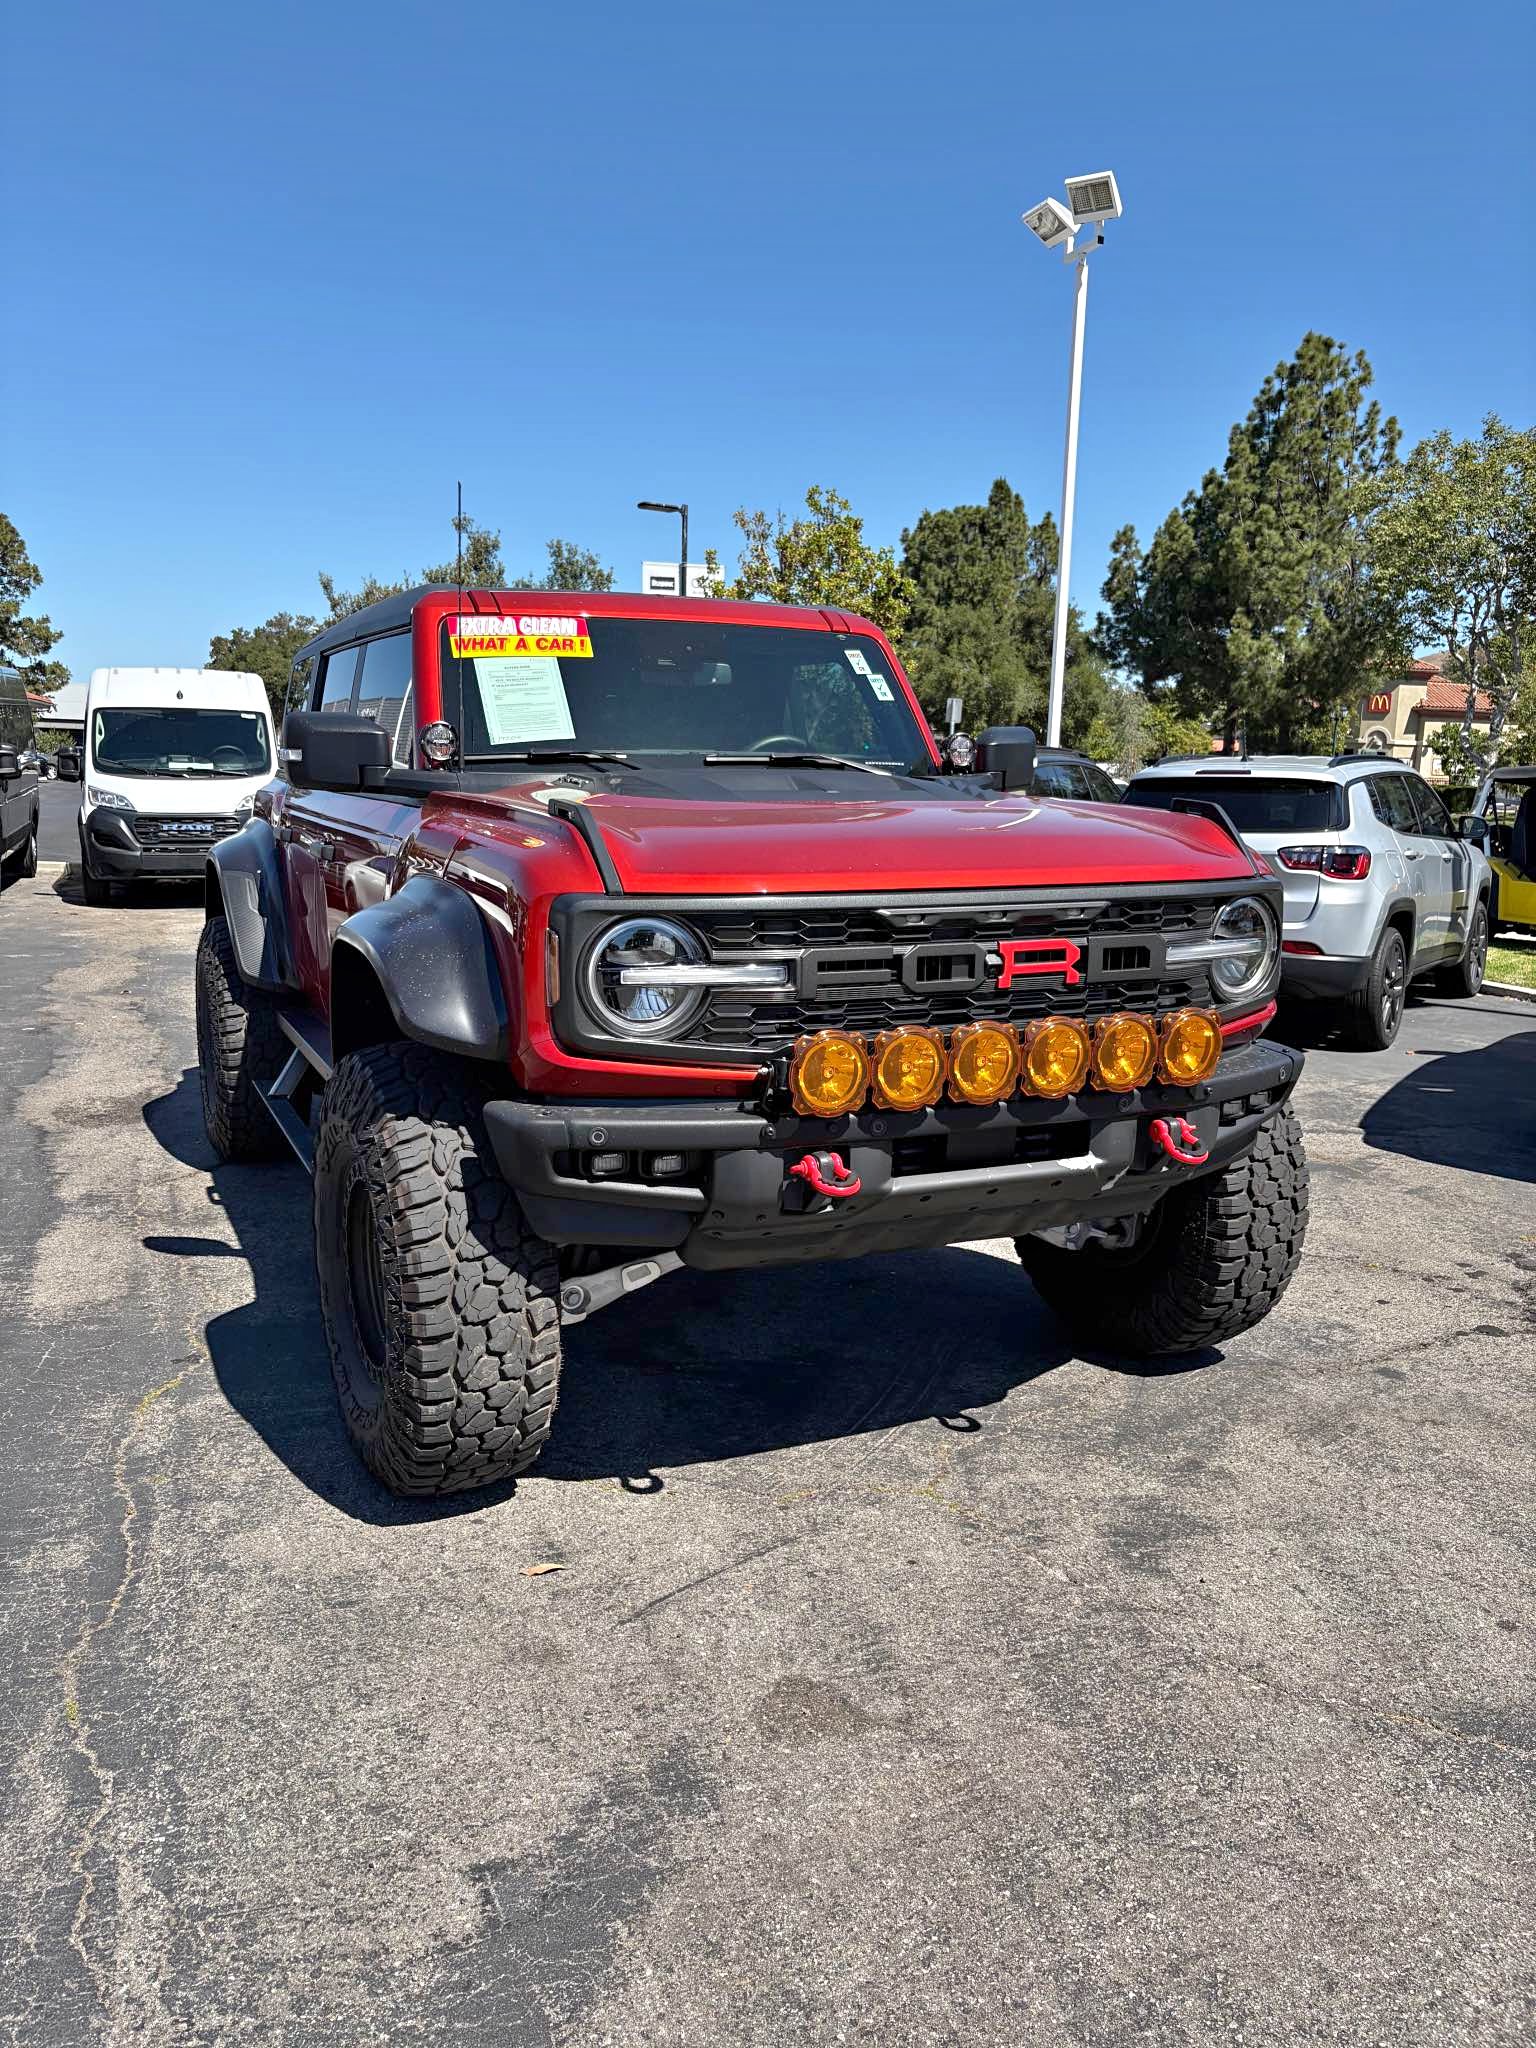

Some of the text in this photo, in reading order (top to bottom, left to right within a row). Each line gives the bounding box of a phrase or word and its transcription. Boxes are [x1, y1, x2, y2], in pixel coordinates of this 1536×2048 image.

[456, 615, 578, 636] EXTRA CLEAN
[454, 637, 508, 652] WHAT
[515, 638, 529, 652] A
[160, 822, 215, 832] RAM
[799, 933, 1167, 1000] FORD
